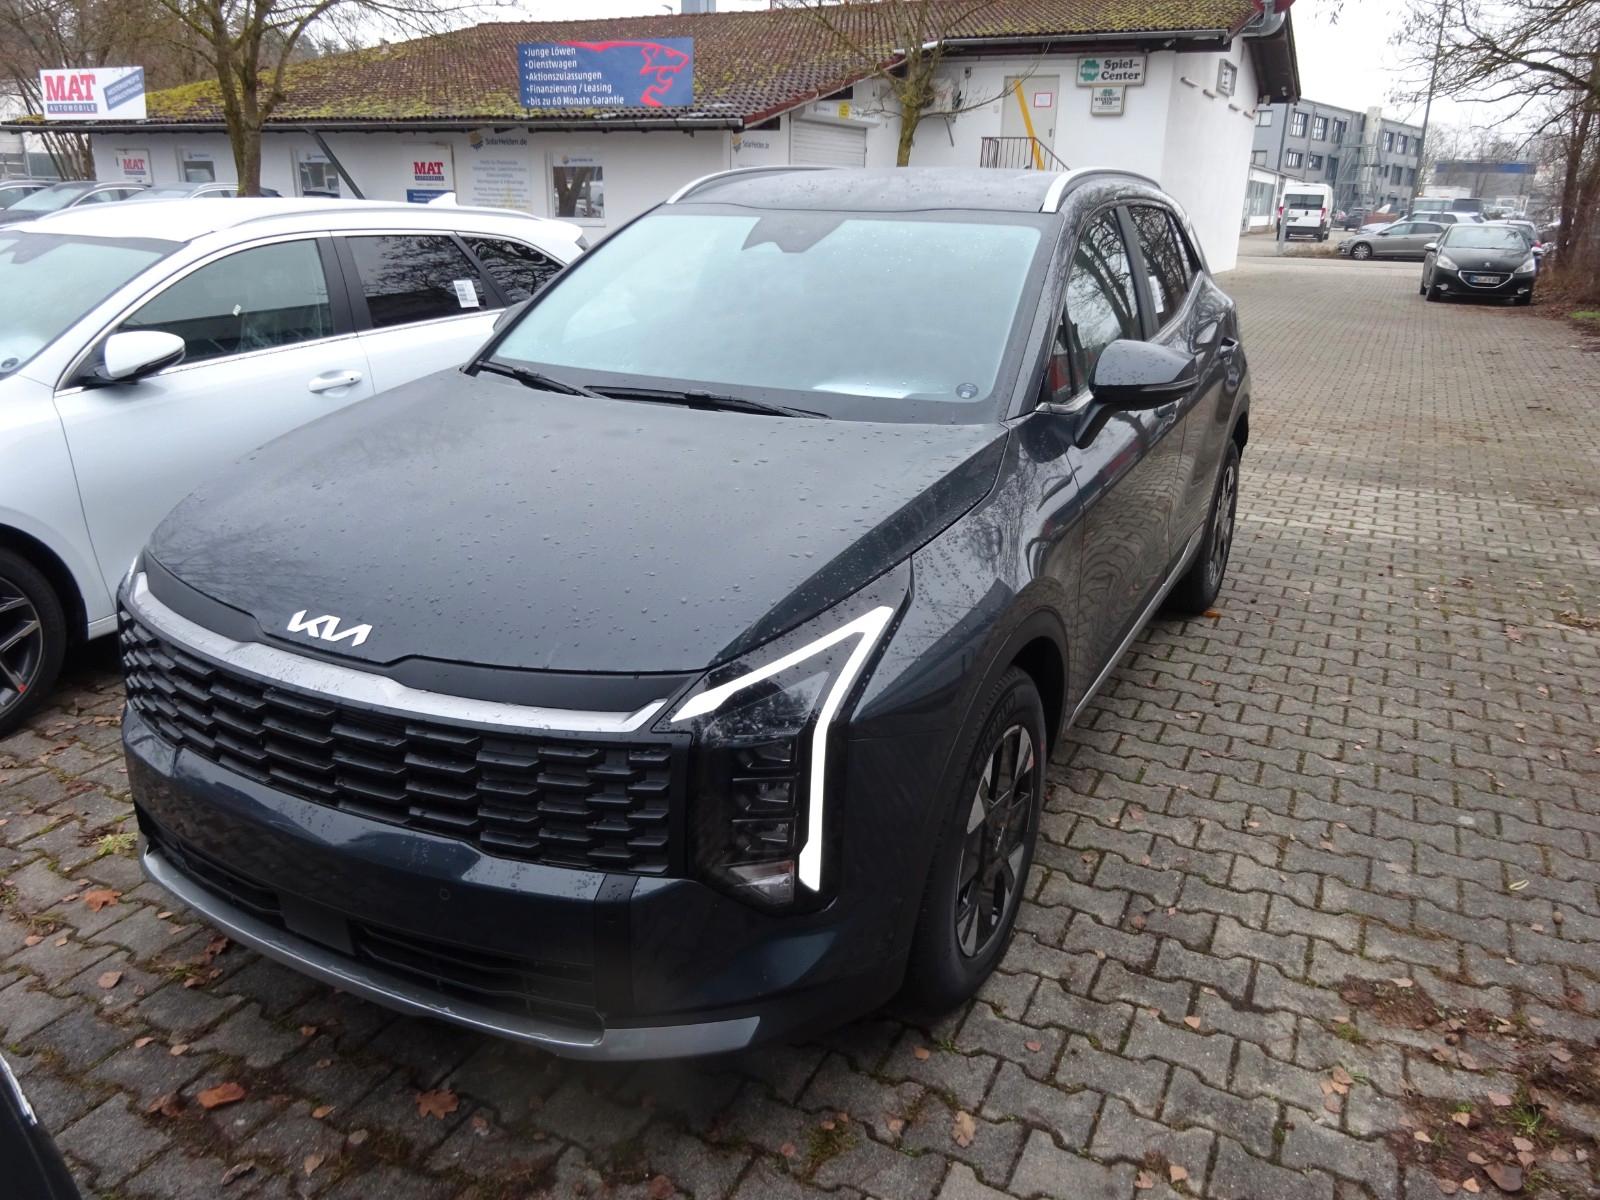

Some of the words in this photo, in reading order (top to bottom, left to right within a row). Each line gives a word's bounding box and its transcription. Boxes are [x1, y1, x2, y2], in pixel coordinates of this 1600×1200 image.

[528, 48, 550, 57] Junge
[551, 47, 576, 56] Löwen
[528, 60, 577, 69] Dienstwagen
[1104, 59, 1140, 71] Spiel-
[528, 72, 602, 81] Aktionszulassungen
[1101, 71, 1141, 80] Center
[44, 74, 97, 101] MAT
[529, 84, 577, 94] Finanzierung
[583, 83, 612, 94] Leasing
[530, 97, 541, 106] bis
[552, 97, 562, 105] 60
[563, 97, 591, 105] Monate
[592, 96, 625, 105] Garantie
[49, 104, 97, 112] AUTOMOBILE
[123, 159, 145, 170] MAT
[413, 161, 444, 175] MAT
